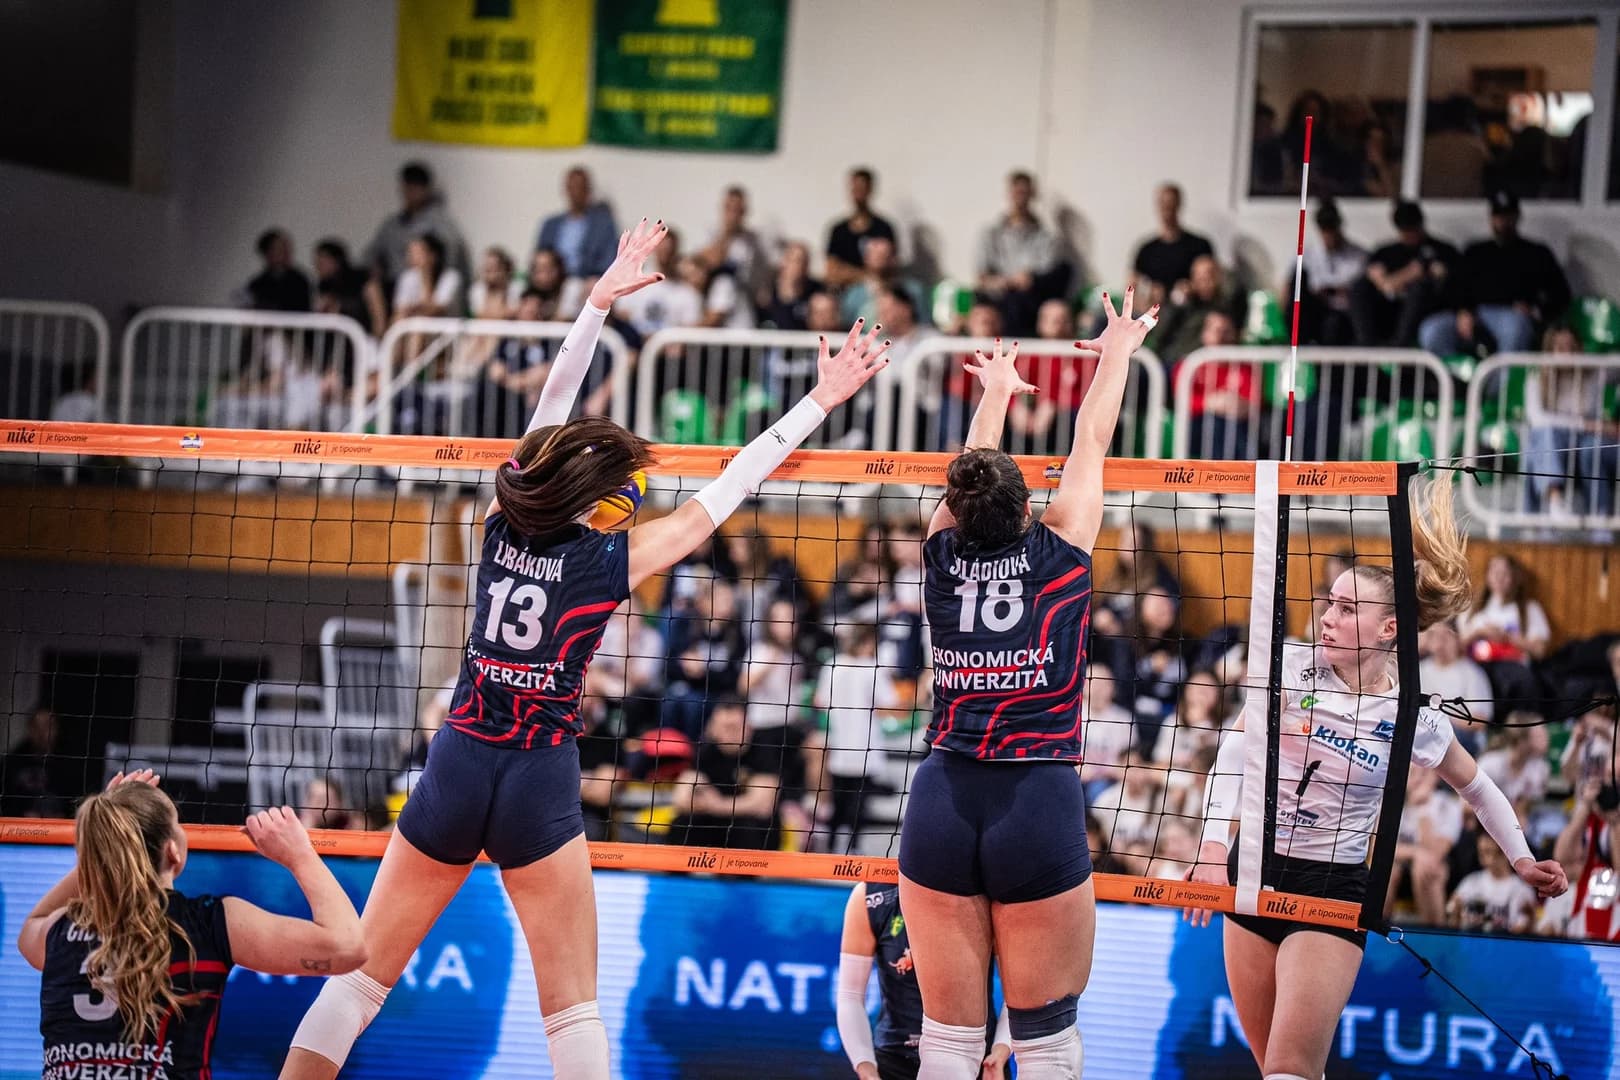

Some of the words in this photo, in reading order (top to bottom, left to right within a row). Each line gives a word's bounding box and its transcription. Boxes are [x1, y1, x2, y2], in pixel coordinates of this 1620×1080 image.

[7, 429, 36, 444] niké
[54, 434, 88, 443] tipovanie
[293, 439, 321, 455] niké
[435, 444, 463, 460] niké
[481, 450, 511, 460] tipovan
[865, 458, 894, 476] niké
[912, 463, 947, 475] tipovanie
[1163, 466, 1194, 485] niké
[1214, 471, 1250, 484] tipovanie
[1296, 468, 1328, 487] niké
[1348, 473, 1385, 485] tipovanie
[484, 577, 547, 650] 13
[954, 579, 1024, 632] 18
[933, 641, 1054, 668] EKONOMICKÁ
[474, 660, 556, 691] VERZITA
[934, 667, 1049, 691] UNIVERZITA
[1315, 725, 1380, 767] Klokan
[687, 851, 717, 868] niké
[735, 858, 768, 869] tipovanie
[833, 860, 862, 877] niké
[881, 867, 898, 877] tipov
[1133, 882, 1163, 900] niké
[1183, 890, 1220, 903] tipovanie
[1266, 897, 1297, 915] niké
[1317, 908, 1355, 921] tipovanie
[1211, 996, 1562, 1073] NTURA
